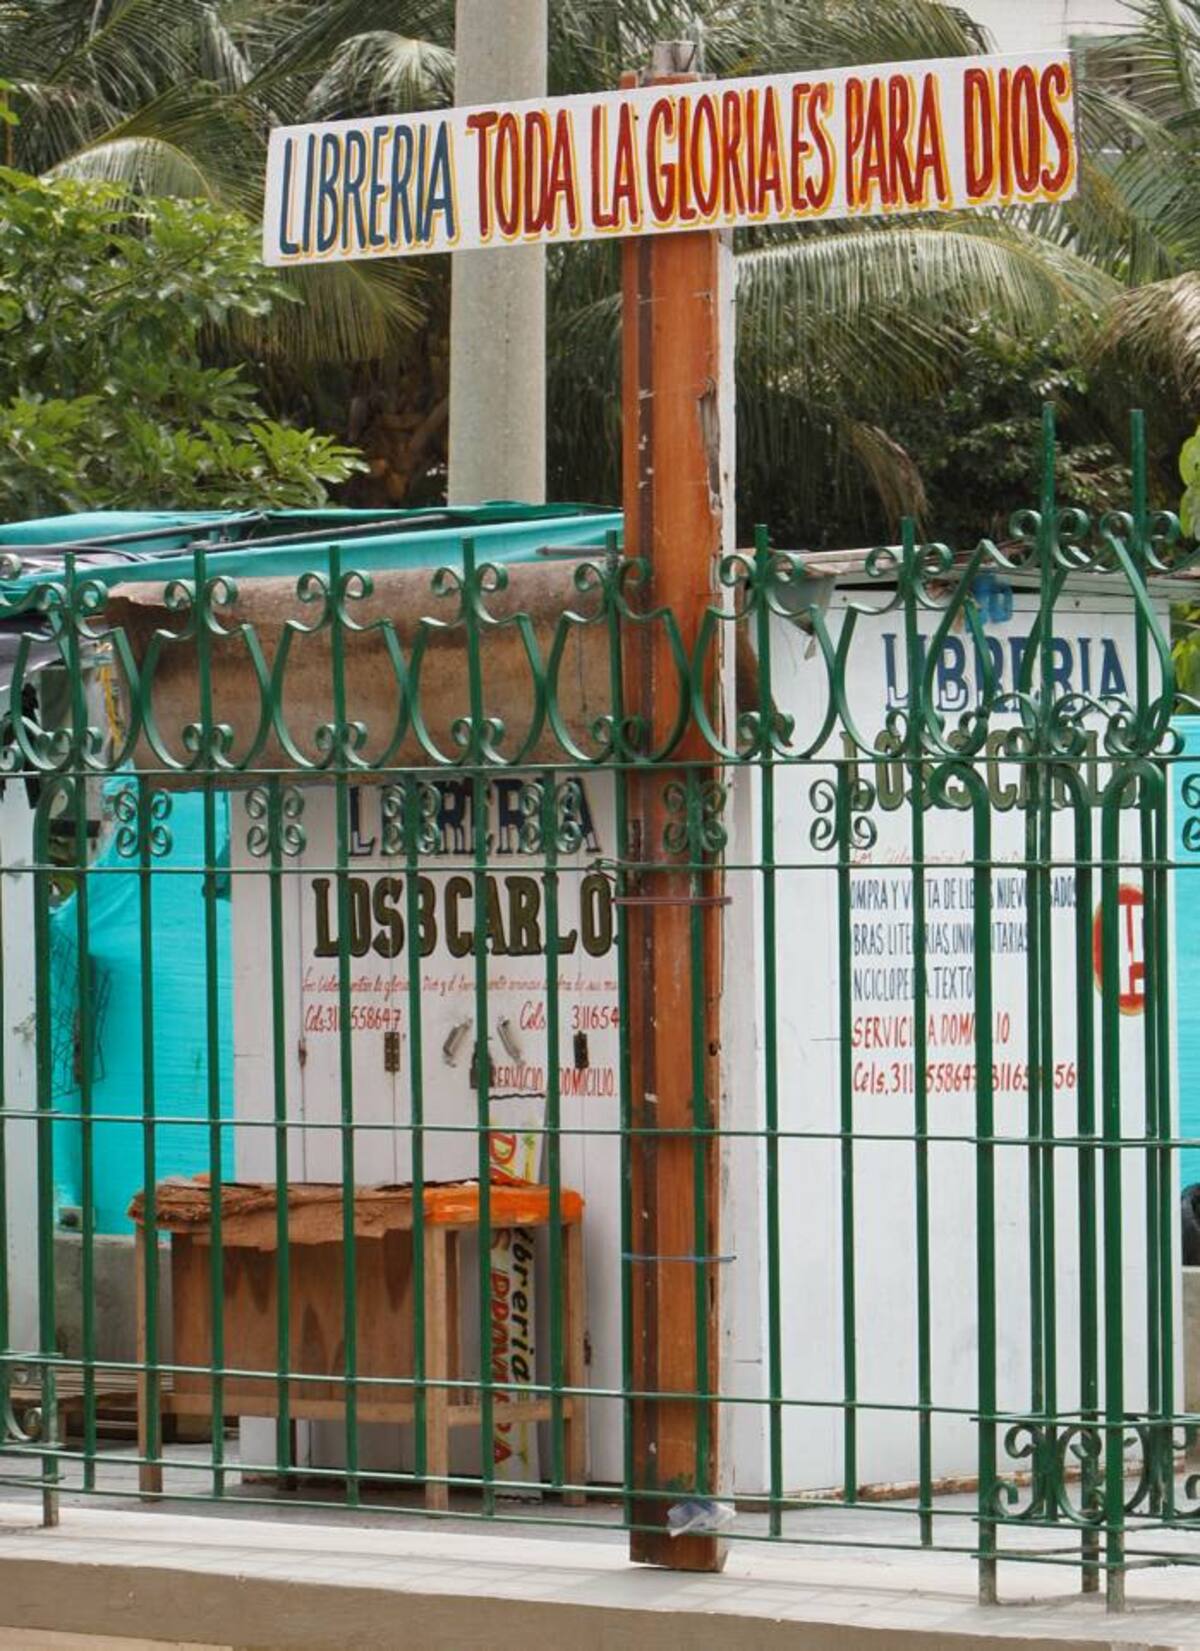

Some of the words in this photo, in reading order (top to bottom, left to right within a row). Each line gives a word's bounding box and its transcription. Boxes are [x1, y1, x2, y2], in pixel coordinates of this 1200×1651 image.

[279, 120, 459, 260] LIBRERIA
[466, 108, 583, 242] TODA
[591, 102, 644, 230] LA
[646, 86, 791, 227] GLORIA
[790, 81, 836, 213] ES
[845, 72, 951, 209] PARA
[963, 63, 1072, 202] DIOS
[850, 878, 888, 910] OMPRA
[901, 878, 941, 910] VTA
[312, 878, 405, 957] LOS
[444, 874, 618, 957] CARLO
[853, 922, 884, 956] BRAS
[933, 965, 976, 999] TEXTO
[851, 1015, 914, 1048] SERVICI
[511, 1227, 535, 1384] ibreria
